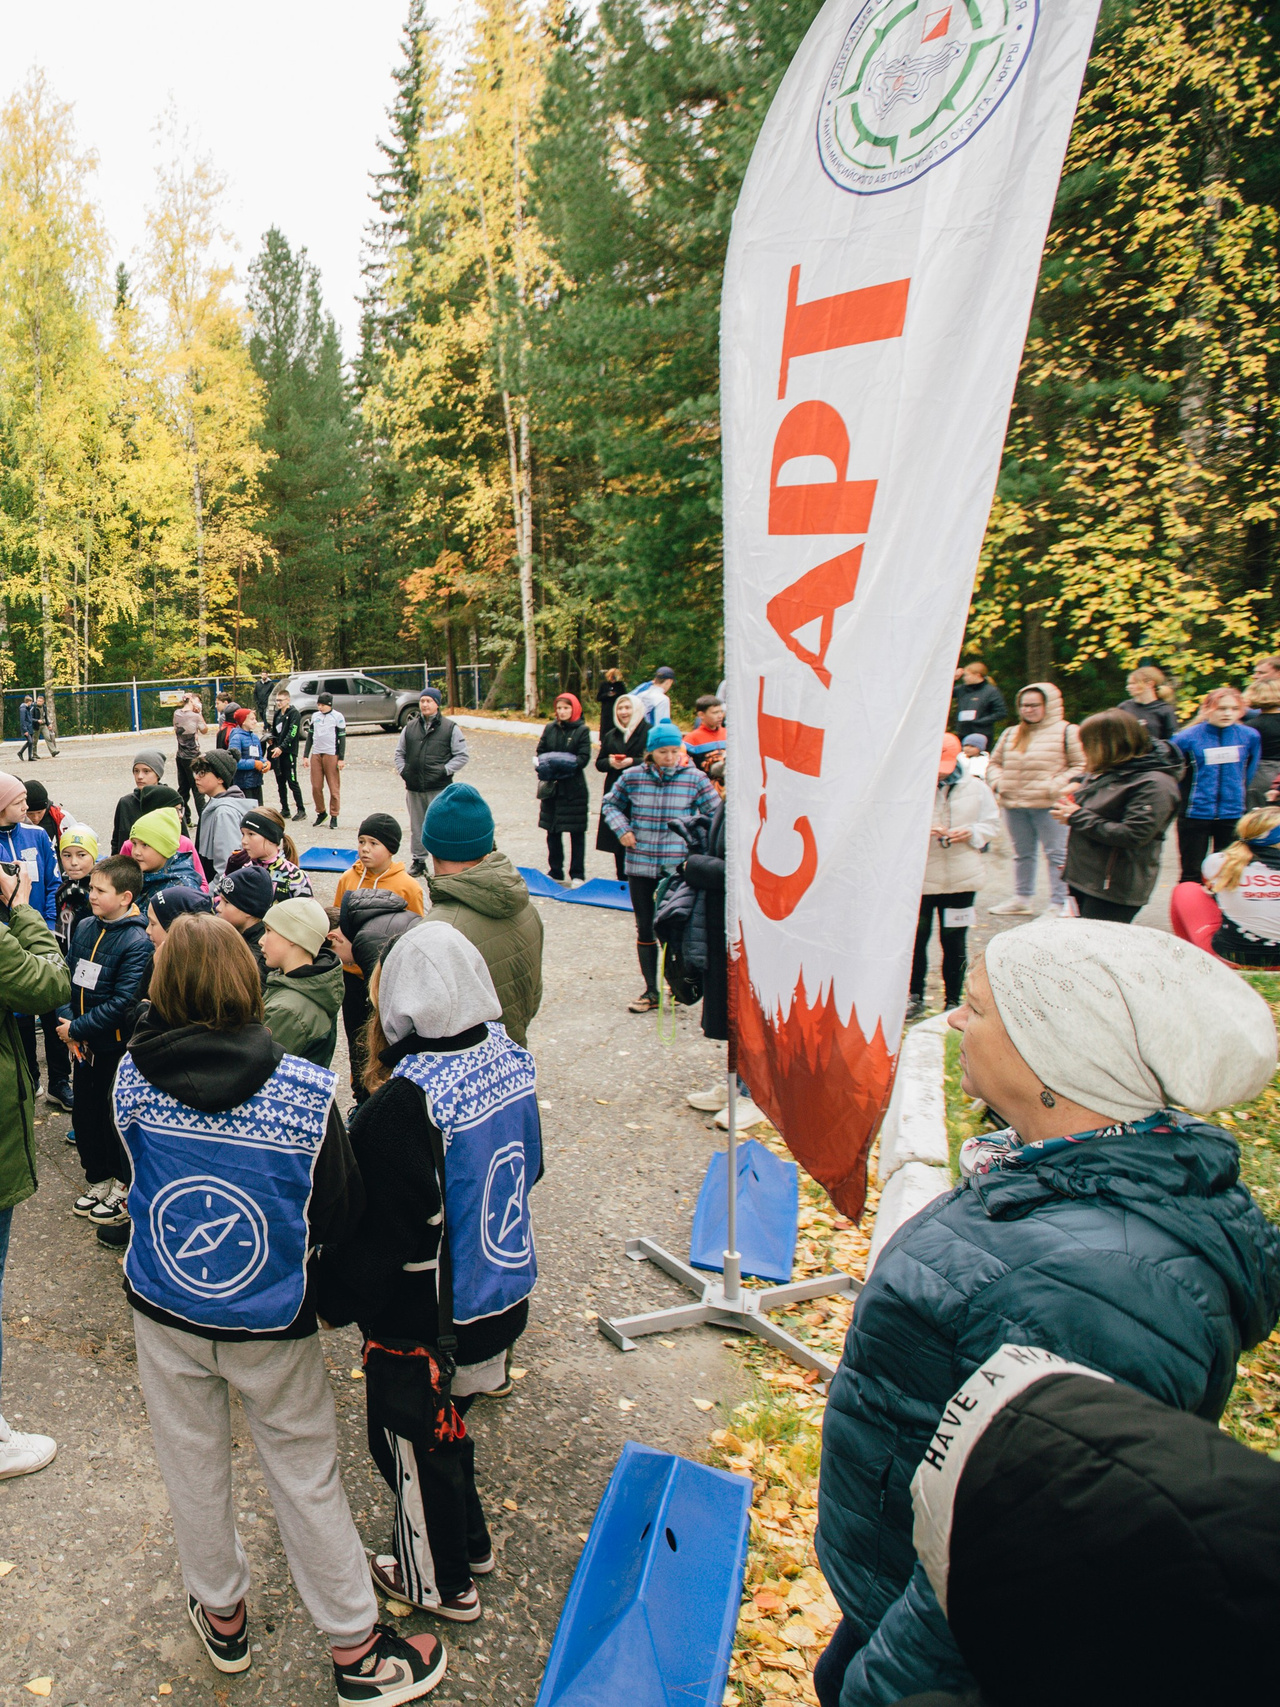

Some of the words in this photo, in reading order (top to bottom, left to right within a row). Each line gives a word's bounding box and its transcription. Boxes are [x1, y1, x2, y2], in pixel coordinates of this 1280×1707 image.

[830, 6, 874, 90] ФЕДЕРАЦИЯ
[874, 139, 948, 184] АВТОНОМНОГО
[950, 96, 994, 141] ОКРУГА
[996, 42, 1021, 82] ЮГРЫ
[750, 264, 911, 921] СТАРТ
[922, 1391, 979, 1471] HAVE
[979, 1369, 1005, 1387] A
